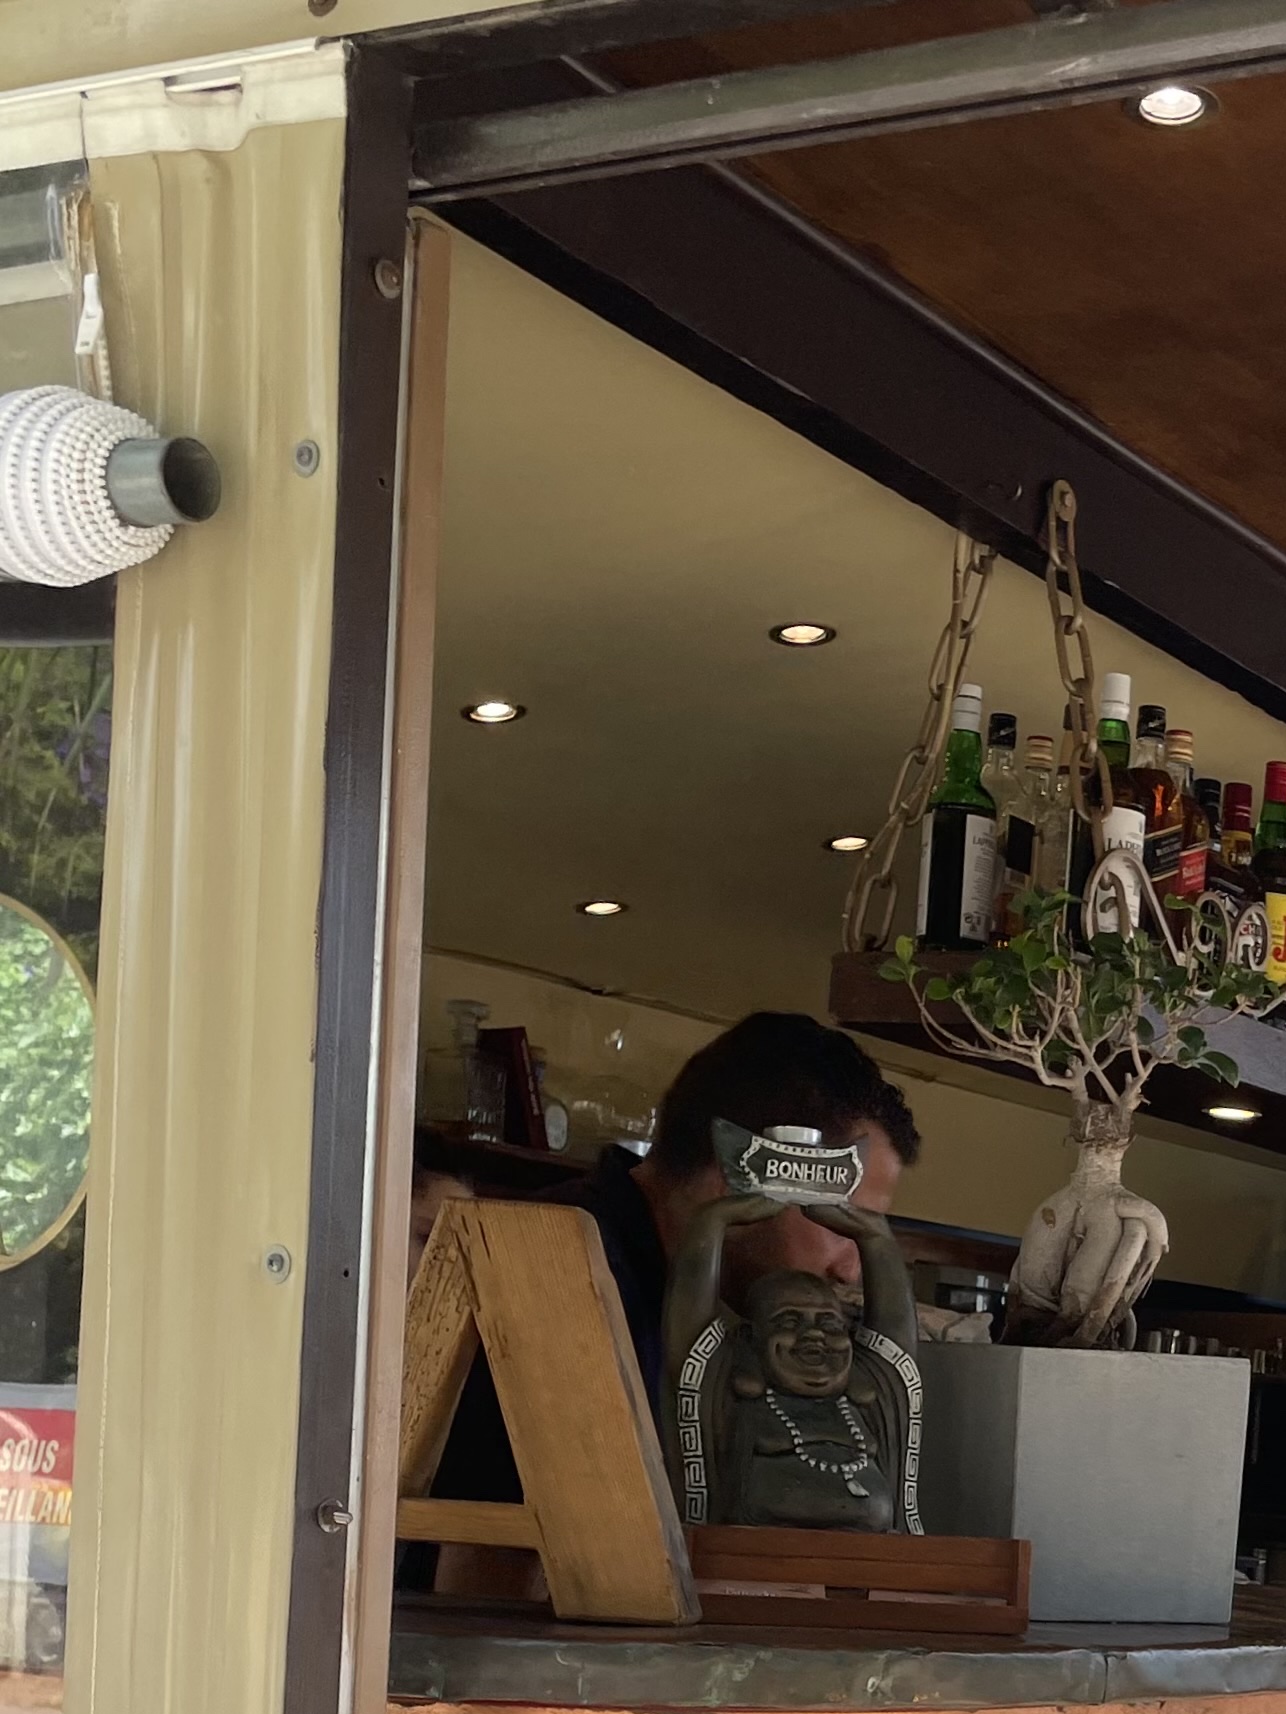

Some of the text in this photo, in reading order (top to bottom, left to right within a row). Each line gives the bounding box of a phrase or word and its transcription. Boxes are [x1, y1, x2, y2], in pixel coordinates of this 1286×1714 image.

[765, 1158, 849, 1185] BONHEUR
[0, 1437, 60, 1474] SOUS
[0, 1487, 72, 1526] EILLAN
